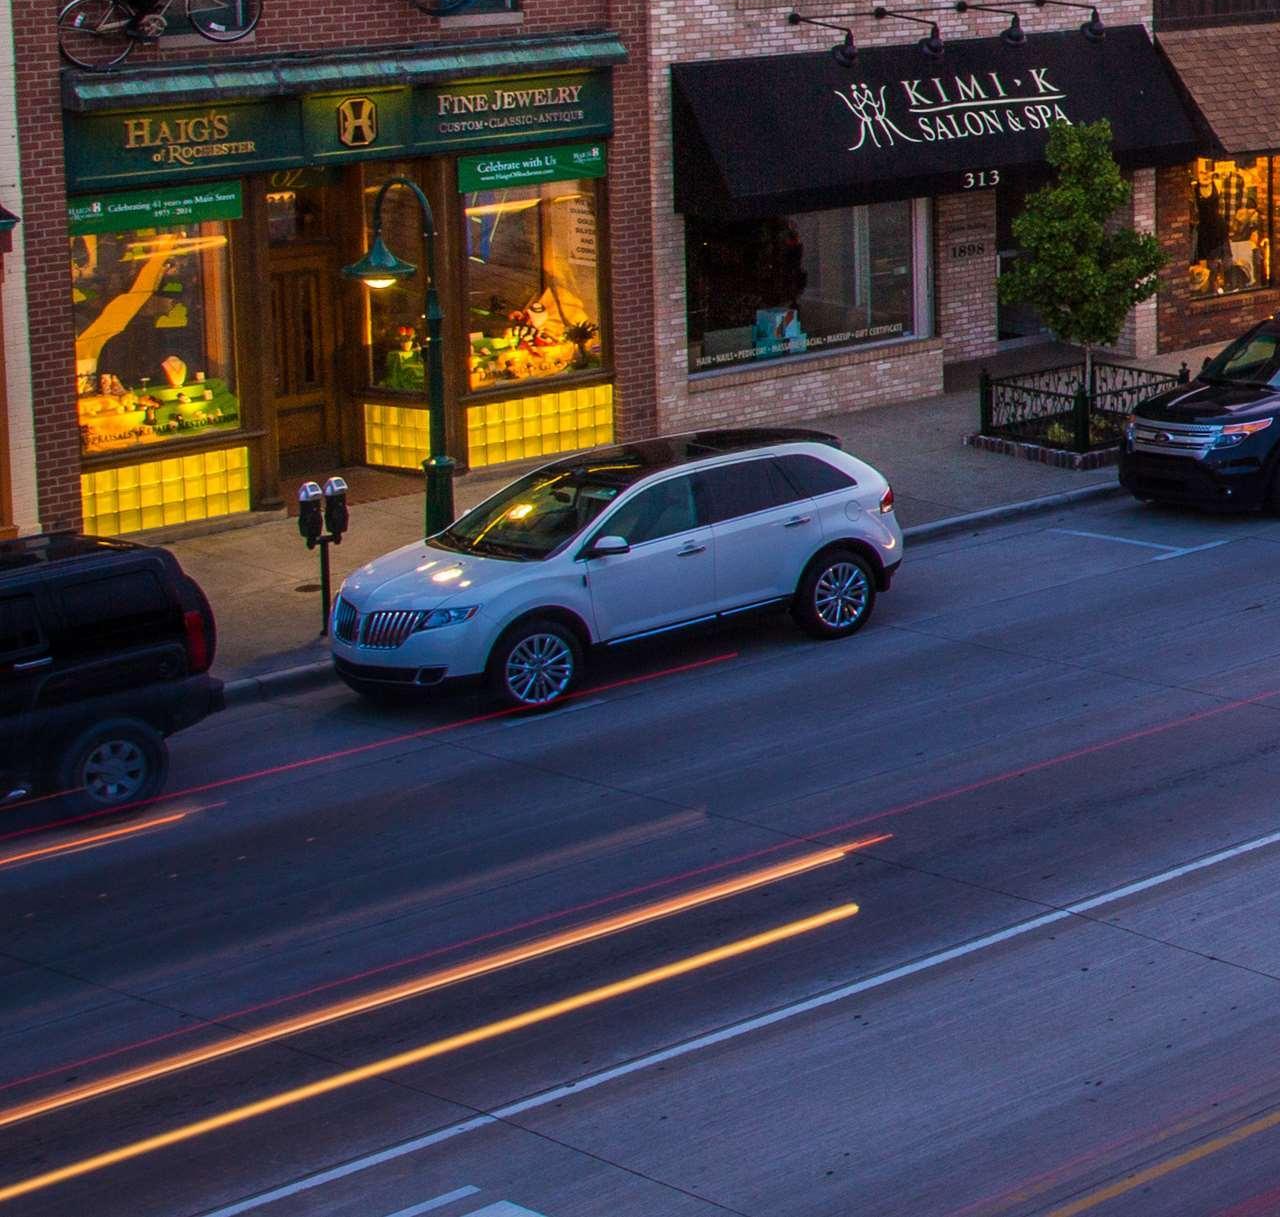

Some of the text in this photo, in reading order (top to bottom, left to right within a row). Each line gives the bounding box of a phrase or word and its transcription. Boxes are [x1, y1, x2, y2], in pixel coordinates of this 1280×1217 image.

[902, 68, 1060, 105] KIMI K
[437, 86, 583, 115] FINE JEWELRY
[124, 110, 229, 149] HAIG'S
[439, 110, 585, 133] CUSTOM CLASSIC ANTIQUE
[918, 103, 1073, 141] SALON & SPA
[152, 140, 256, 165] of ROCHESTER
[477, 156, 557, 173] Celebrate with Us
[963, 170, 1000, 189] 313
[107, 201, 151, 213] Celebrating
[194, 195, 213, 203] Main
[215, 193, 236, 202] Street
[951, 243, 985, 259] 1898
[716, 352, 734, 363] NAILS
